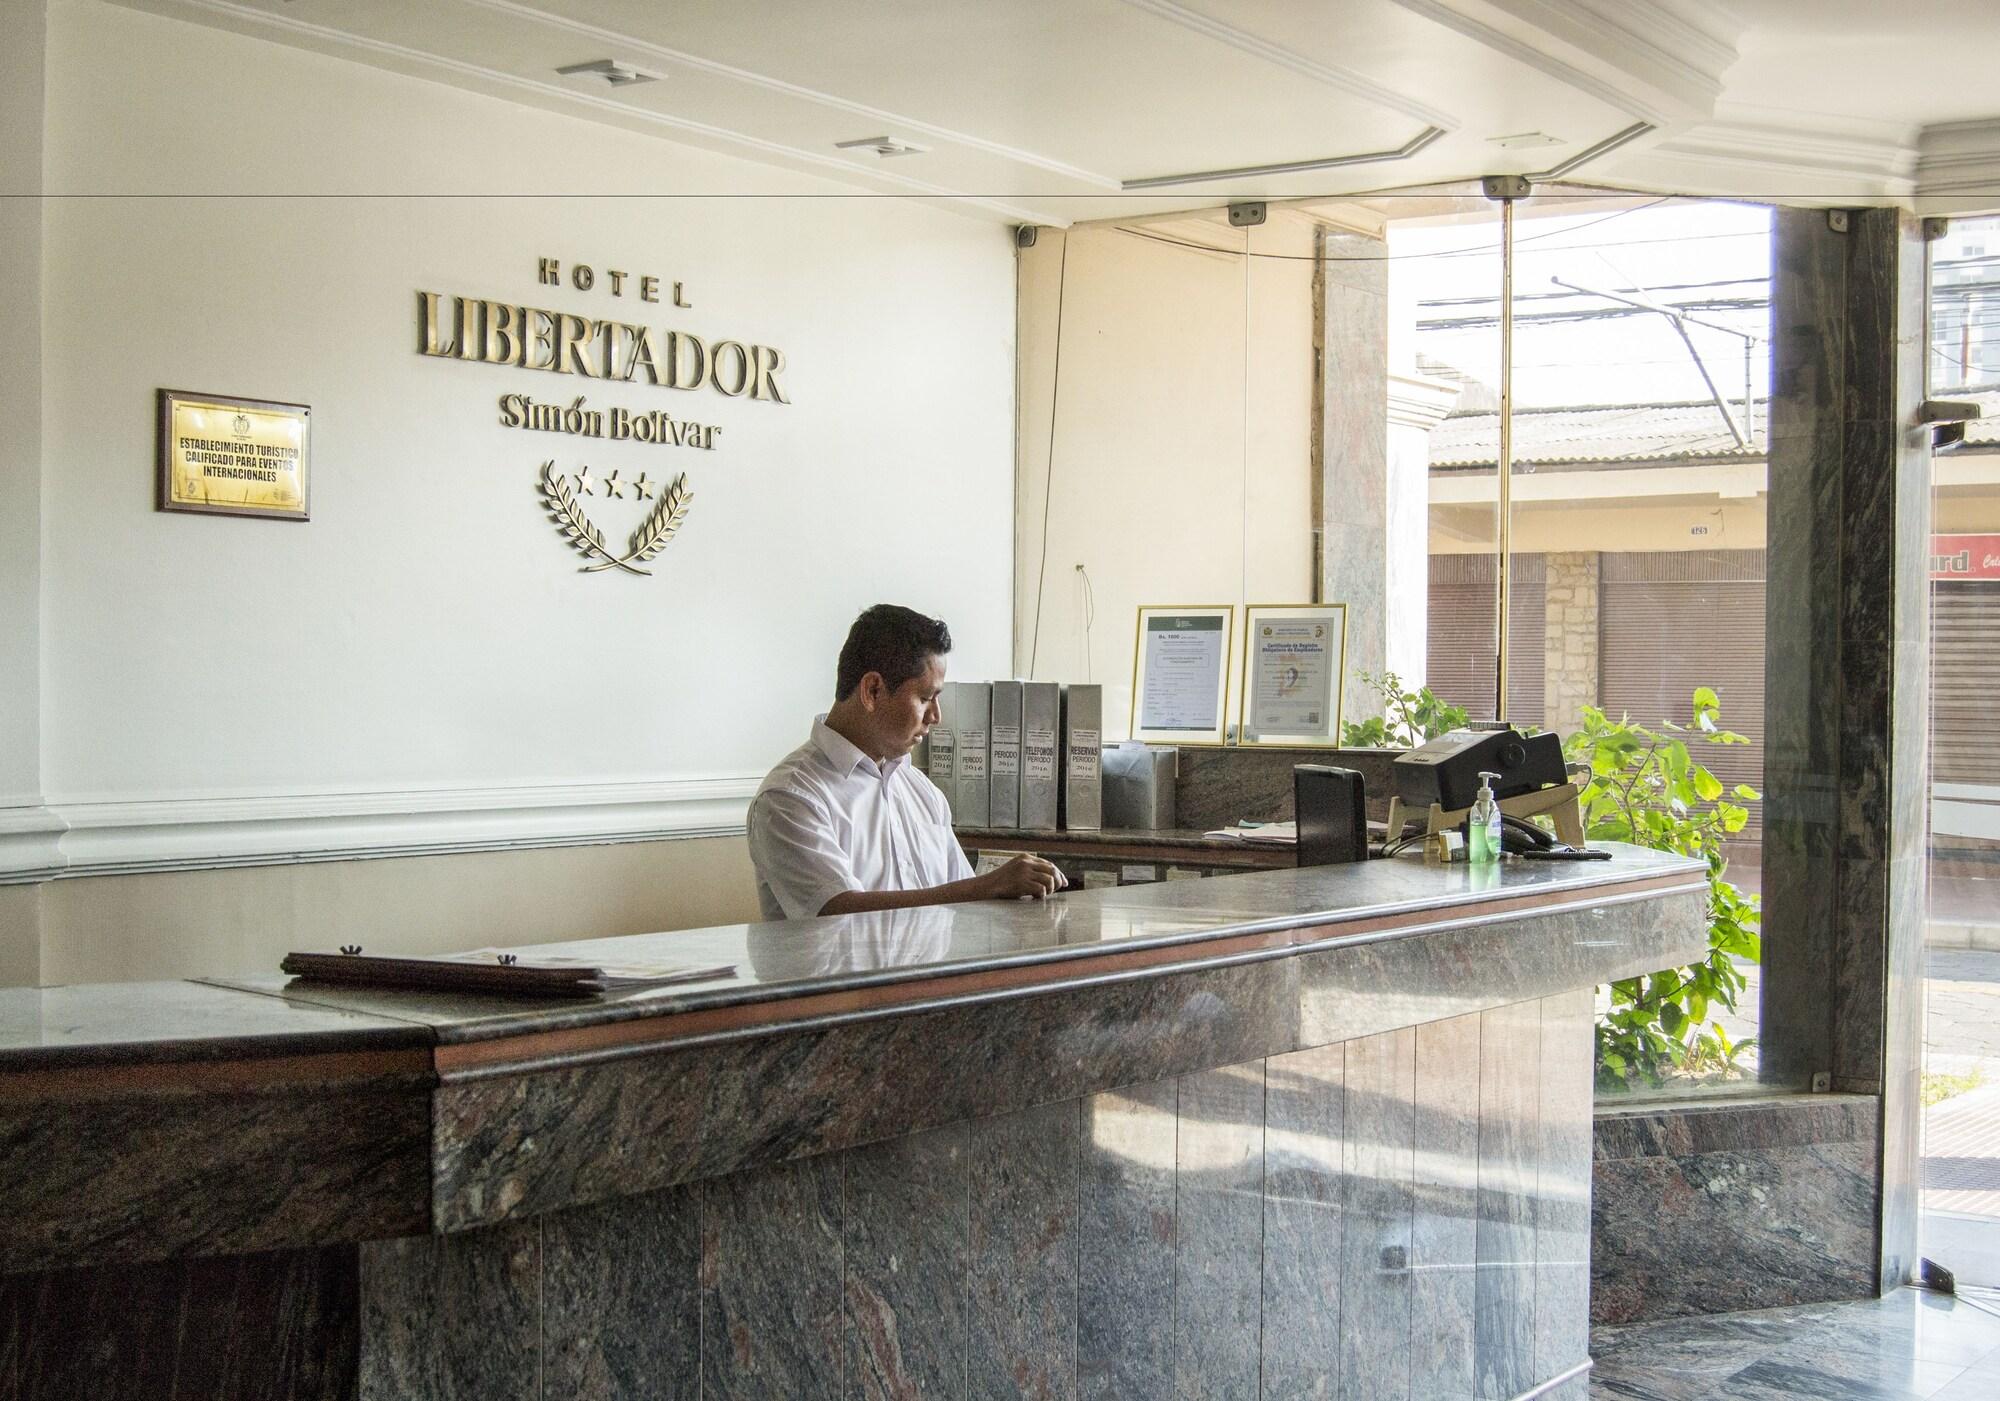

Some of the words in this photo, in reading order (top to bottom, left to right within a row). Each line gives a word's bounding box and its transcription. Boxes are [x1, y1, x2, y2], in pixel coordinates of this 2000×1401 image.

[539, 257, 692, 308] HOTEL
[417, 290, 791, 404] LIBERTADOR
[499, 394, 606, 438] Simón
[180, 437, 254, 455] ESTABLECIMIENTO
[185, 451, 234, 466] CALIFICADO
[236, 455, 257, 468] PARA
[259, 458, 295, 471] EVENTOS
[203, 466, 277, 482] INTERNACIONALES
[994, 750, 1018, 759] PERIODO
[1025, 746, 1054, 756] TELEFONOS
[1071, 746, 1098, 756] RESERVAS
[962, 756, 983, 764] PERIODO
[1027, 755, 1051, 763] PERIODO
[1072, 755, 1096, 763] PERIODO
